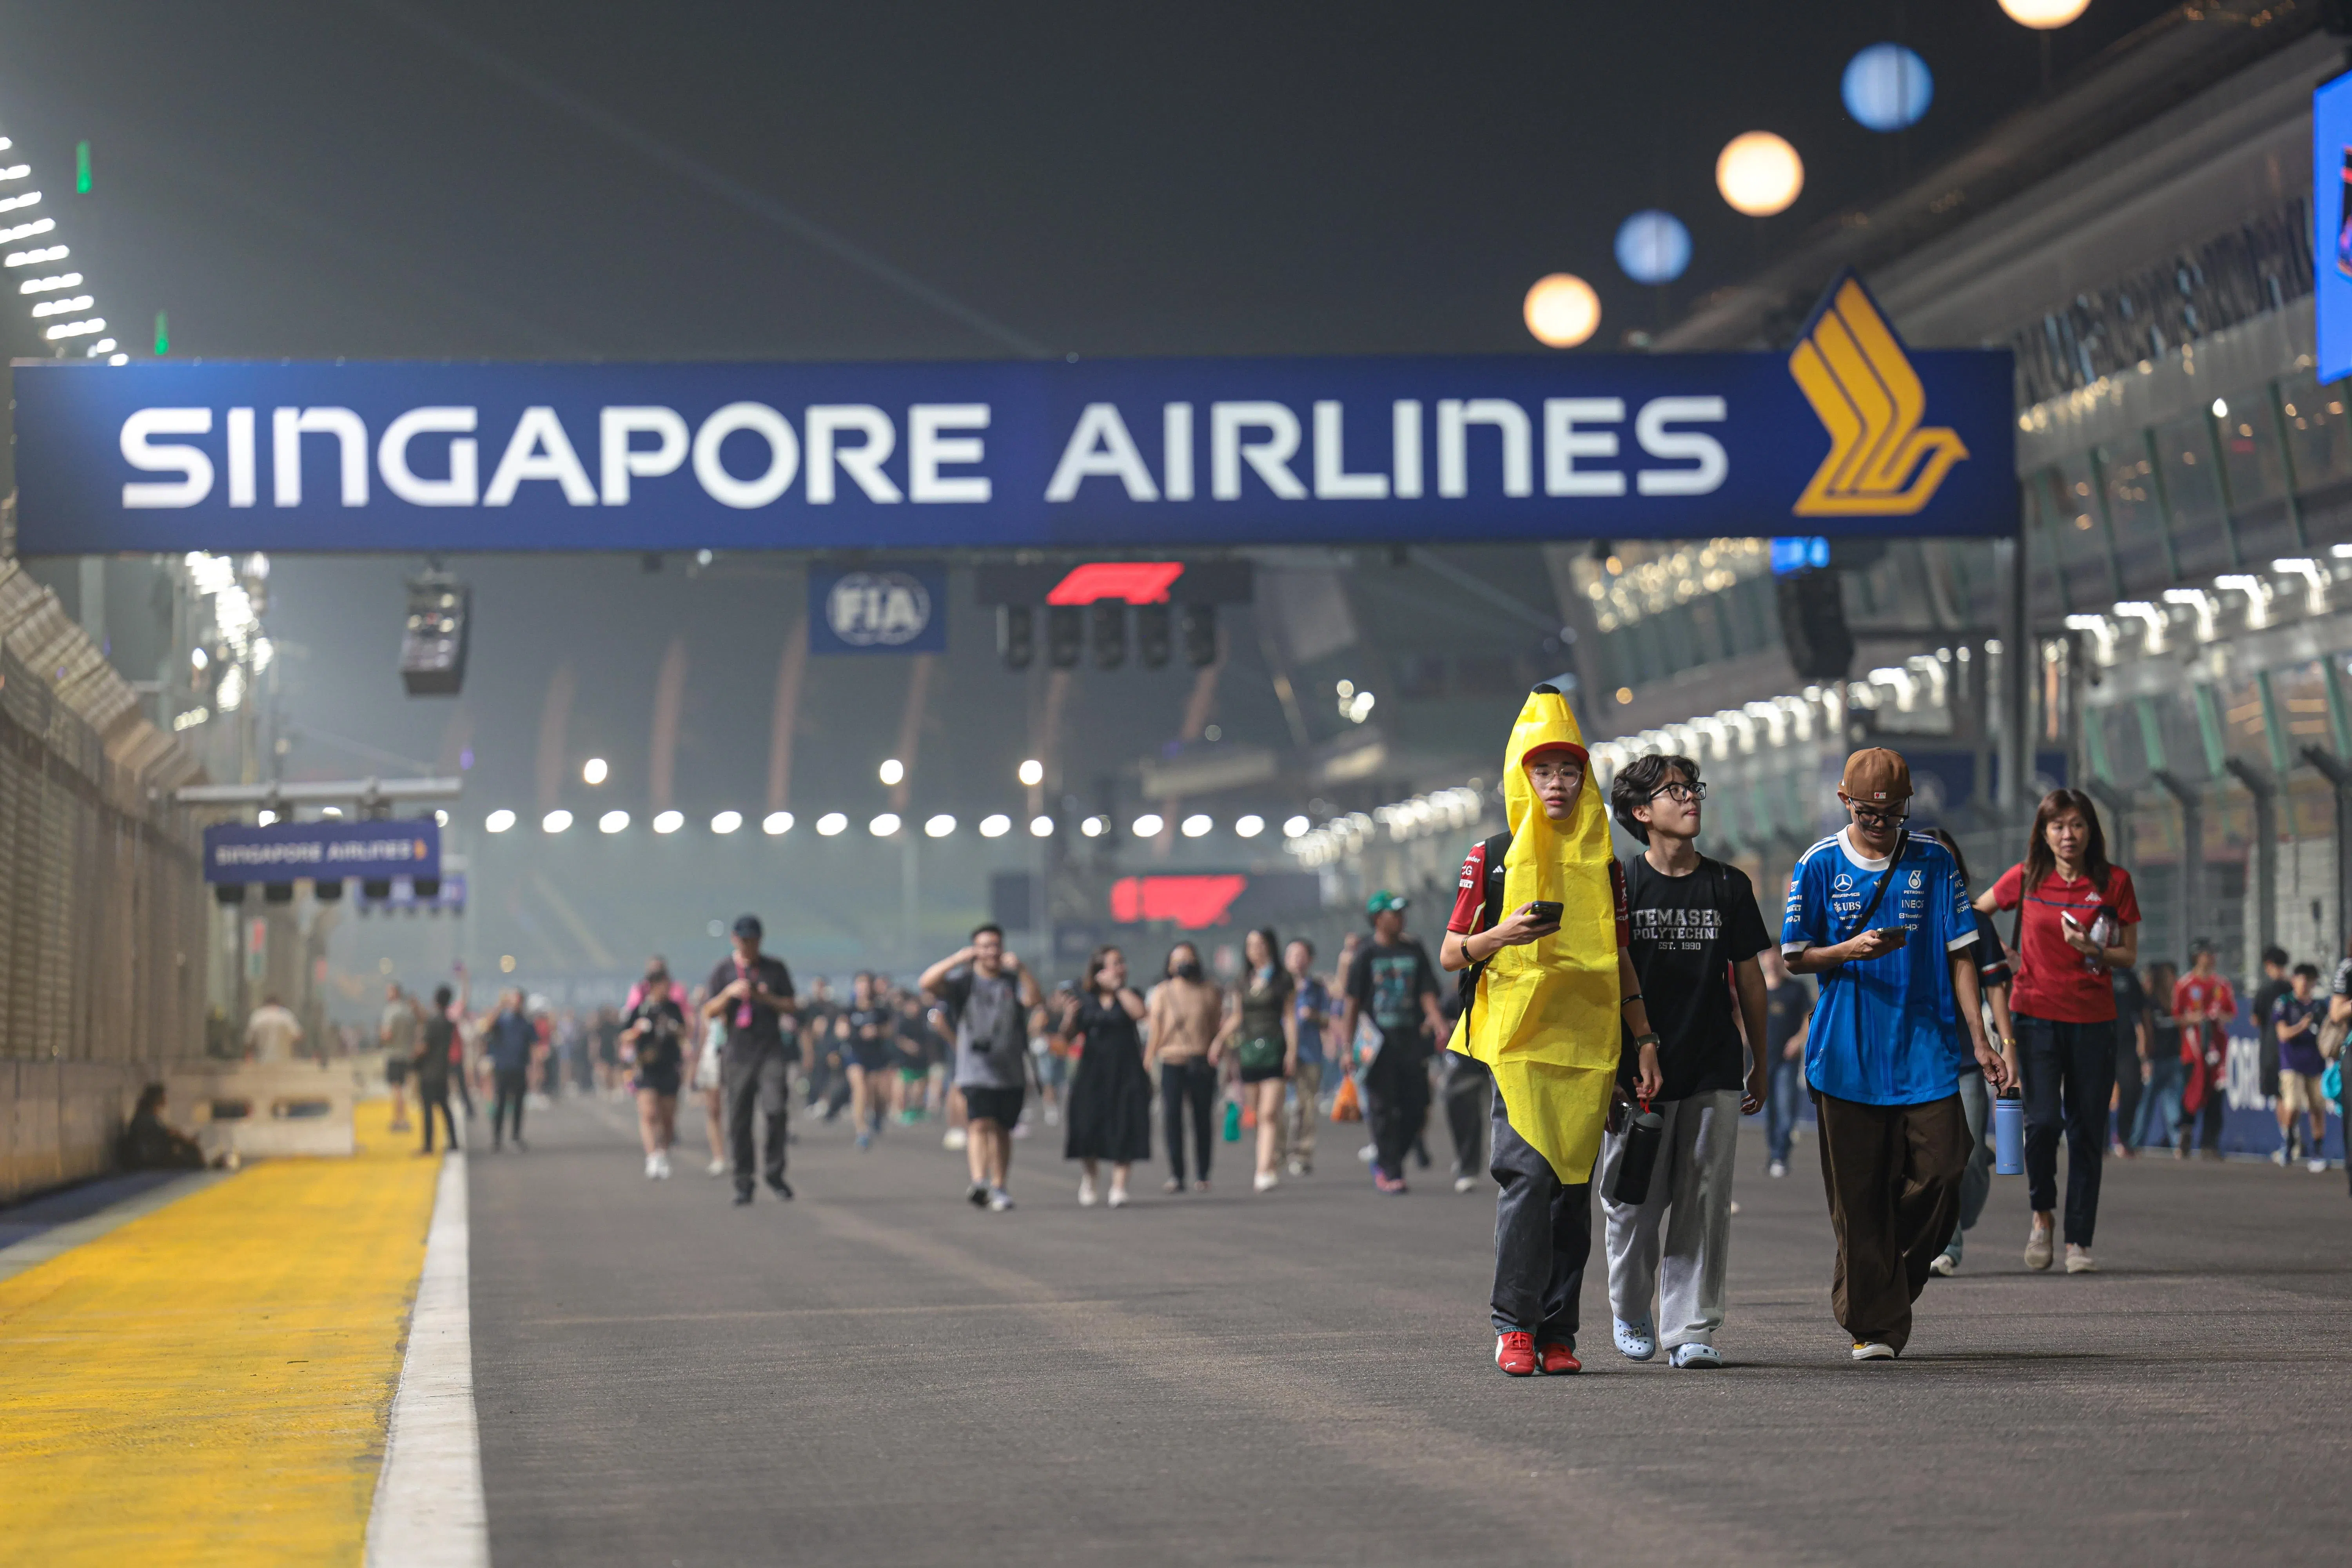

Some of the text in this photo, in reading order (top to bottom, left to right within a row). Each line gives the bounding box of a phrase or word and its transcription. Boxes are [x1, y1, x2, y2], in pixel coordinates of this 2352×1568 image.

[119, 397, 1727, 509] SINGAPORE AIRLINES
[833, 588, 920, 630] FIA
[1842, 901, 1861, 911] UBS
[1631, 908, 1722, 927] TEMASEK
[1633, 927, 1719, 940] POLYTECHNI
[1682, 942, 1701, 950] 1990
